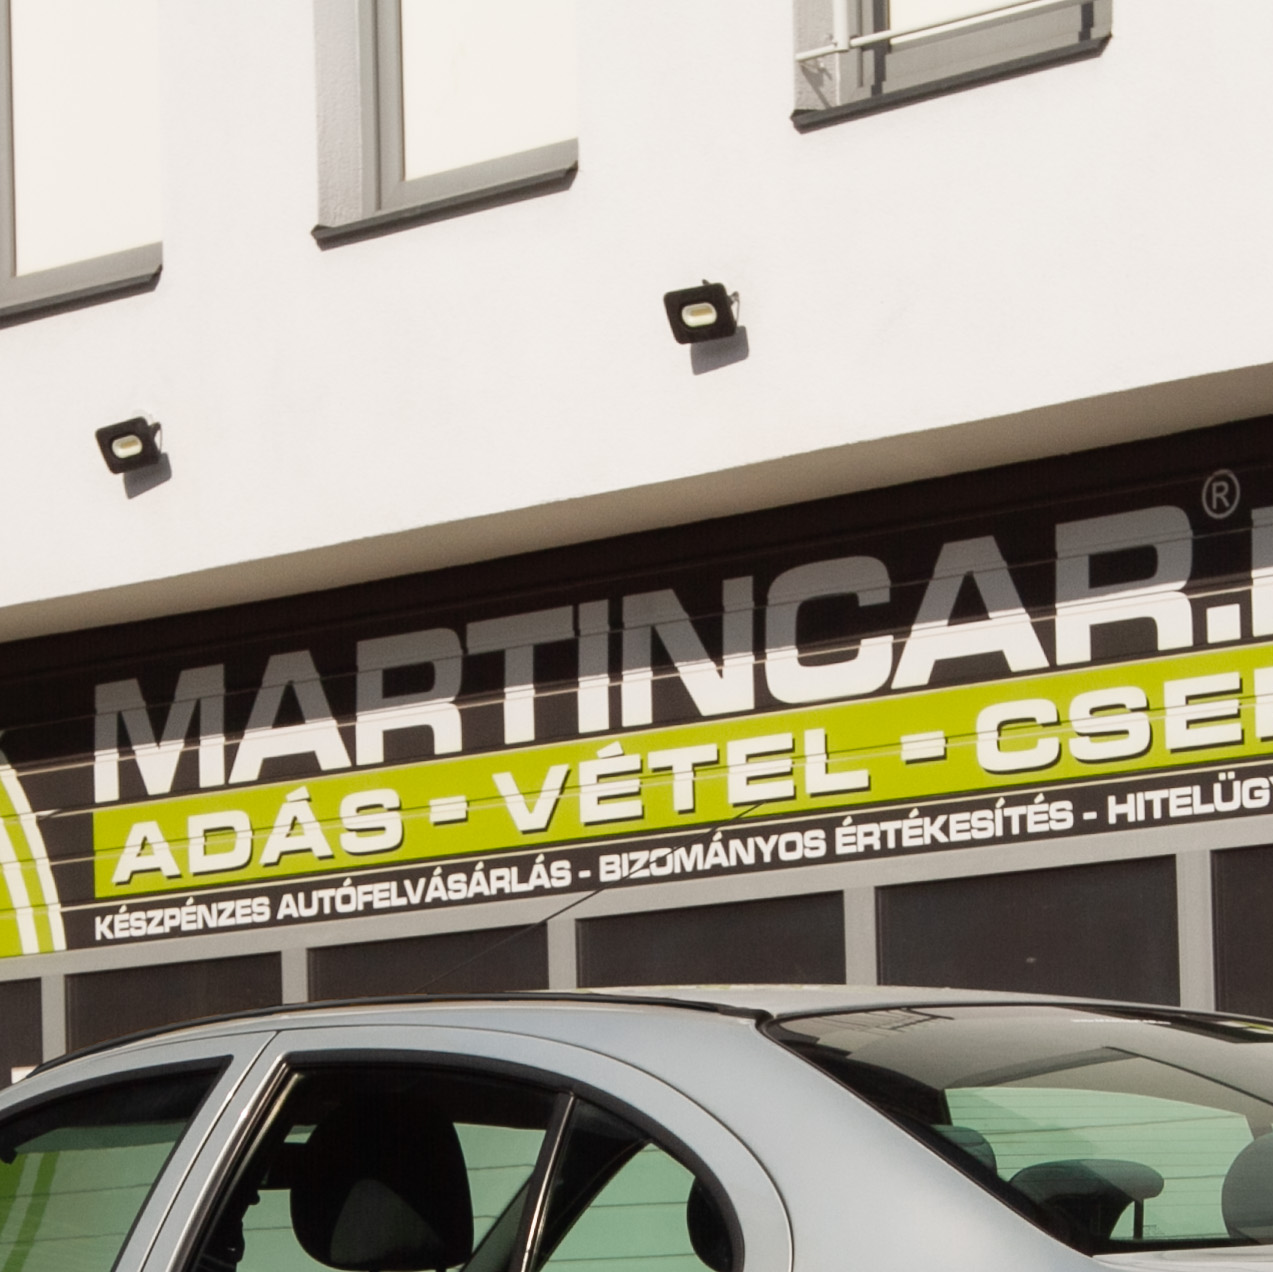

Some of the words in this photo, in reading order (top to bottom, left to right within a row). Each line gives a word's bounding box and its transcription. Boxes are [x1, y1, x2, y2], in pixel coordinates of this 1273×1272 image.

[94, 896, 270, 941] KÉSZPÉNZES
[277, 853, 571, 920] AUTÓFELVÁSÁRLÁS
[599, 830, 827, 883] BIZOMÁNYOS
[835, 793, 1074, 855] ÉRTÉKESÍTÉS
[110, 786, 406, 885] ADÁS
[491, 727, 870, 833] VÉTEL
